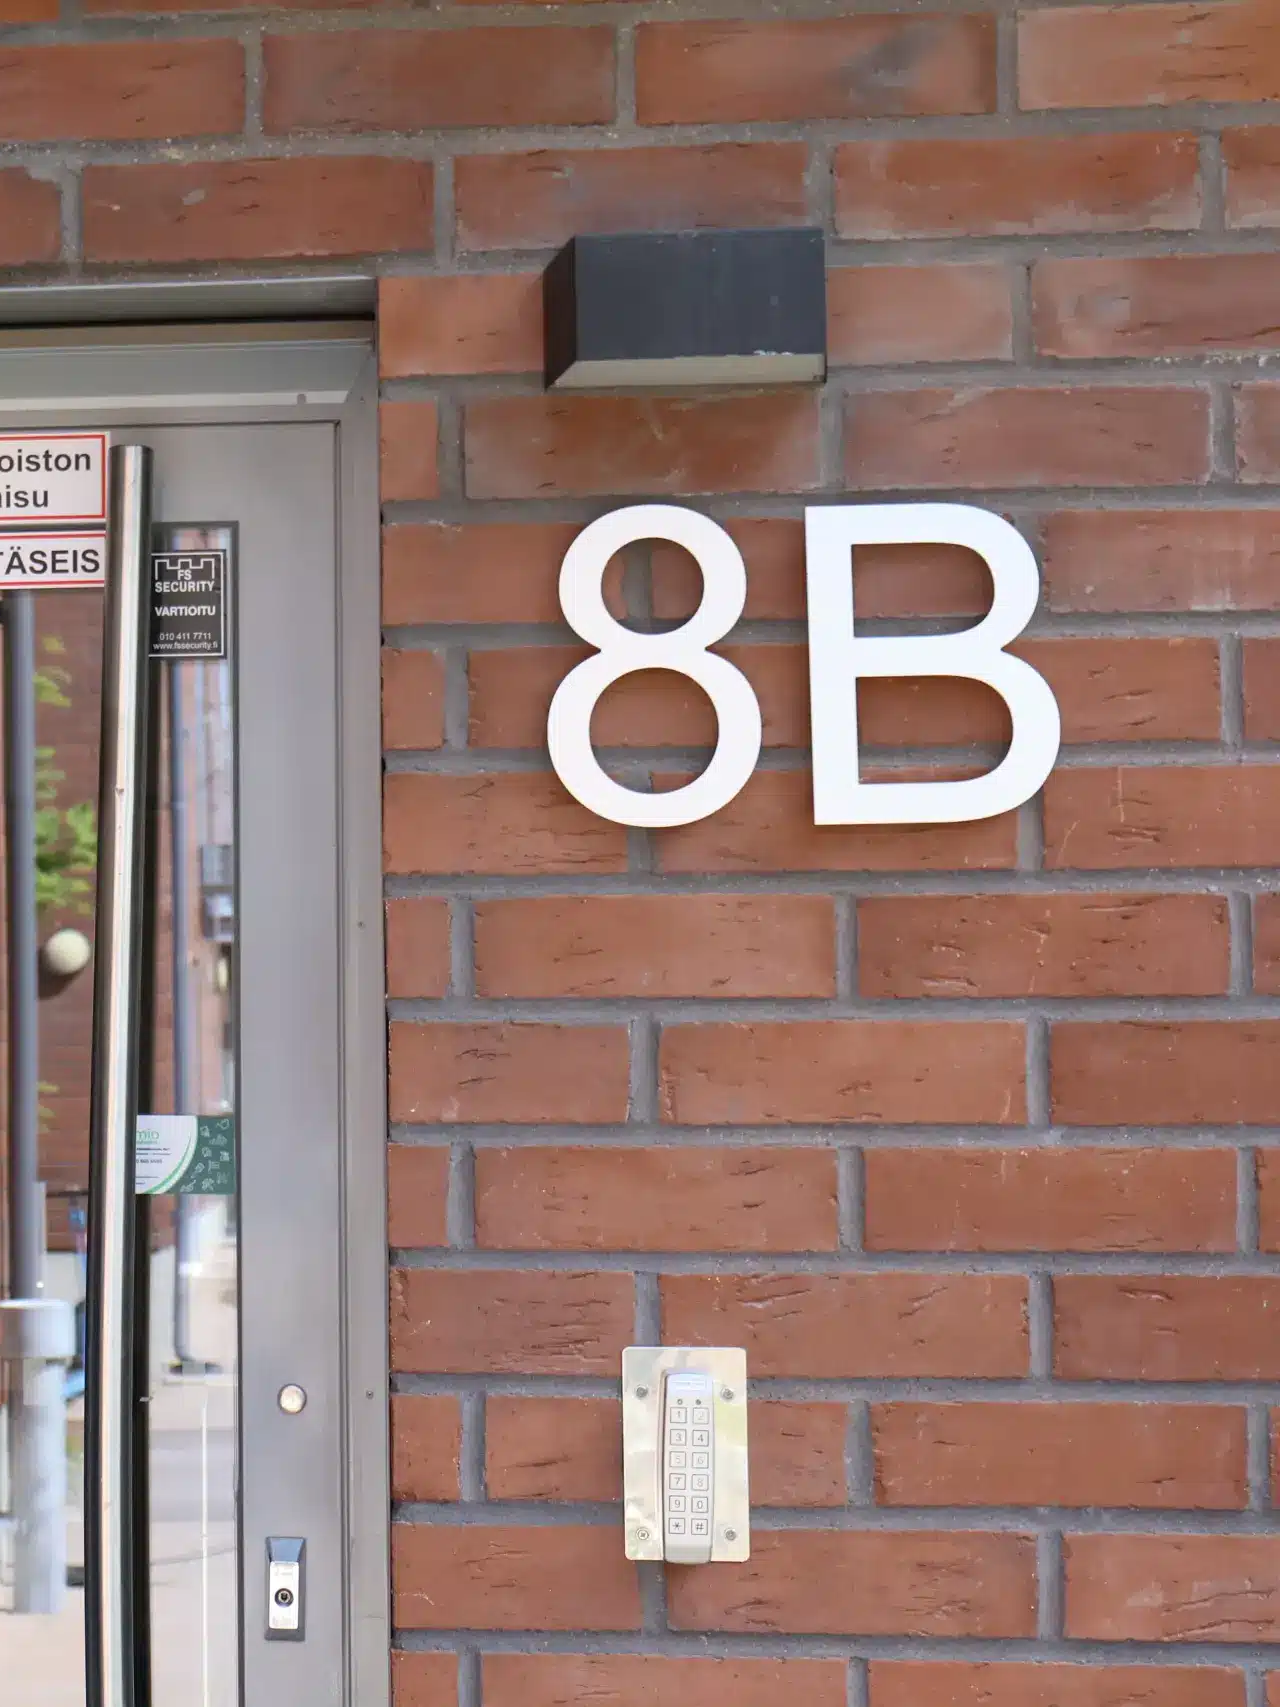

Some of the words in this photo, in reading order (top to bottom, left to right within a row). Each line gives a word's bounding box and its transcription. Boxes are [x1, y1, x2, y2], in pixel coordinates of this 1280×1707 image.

[177, 569, 192, 580] FS
[155, 581, 215, 593] SECURITY
[154, 605, 216, 616] VARTIOITU
[176, 632, 190, 640] 411
[193, 632, 211, 640] 7711
[153, 641, 218, 650] www.fssecurity.fi
